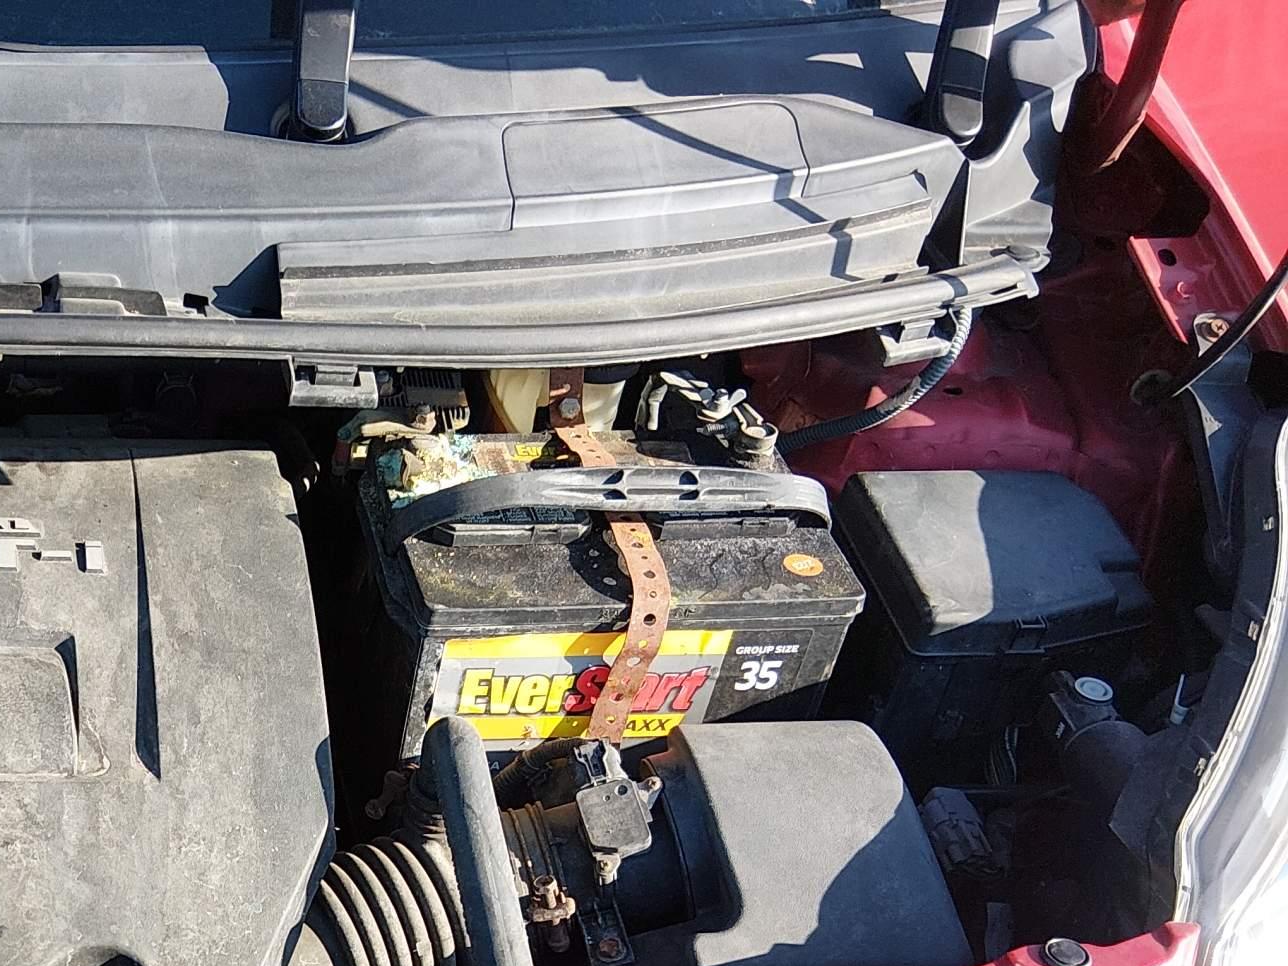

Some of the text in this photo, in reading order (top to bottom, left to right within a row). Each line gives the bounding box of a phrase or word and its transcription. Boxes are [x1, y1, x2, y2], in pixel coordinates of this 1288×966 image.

[735, 645, 800, 656] GROUP SIZE
[457, 665, 709, 714] EverSart
[734, 660, 783, 691] 35
